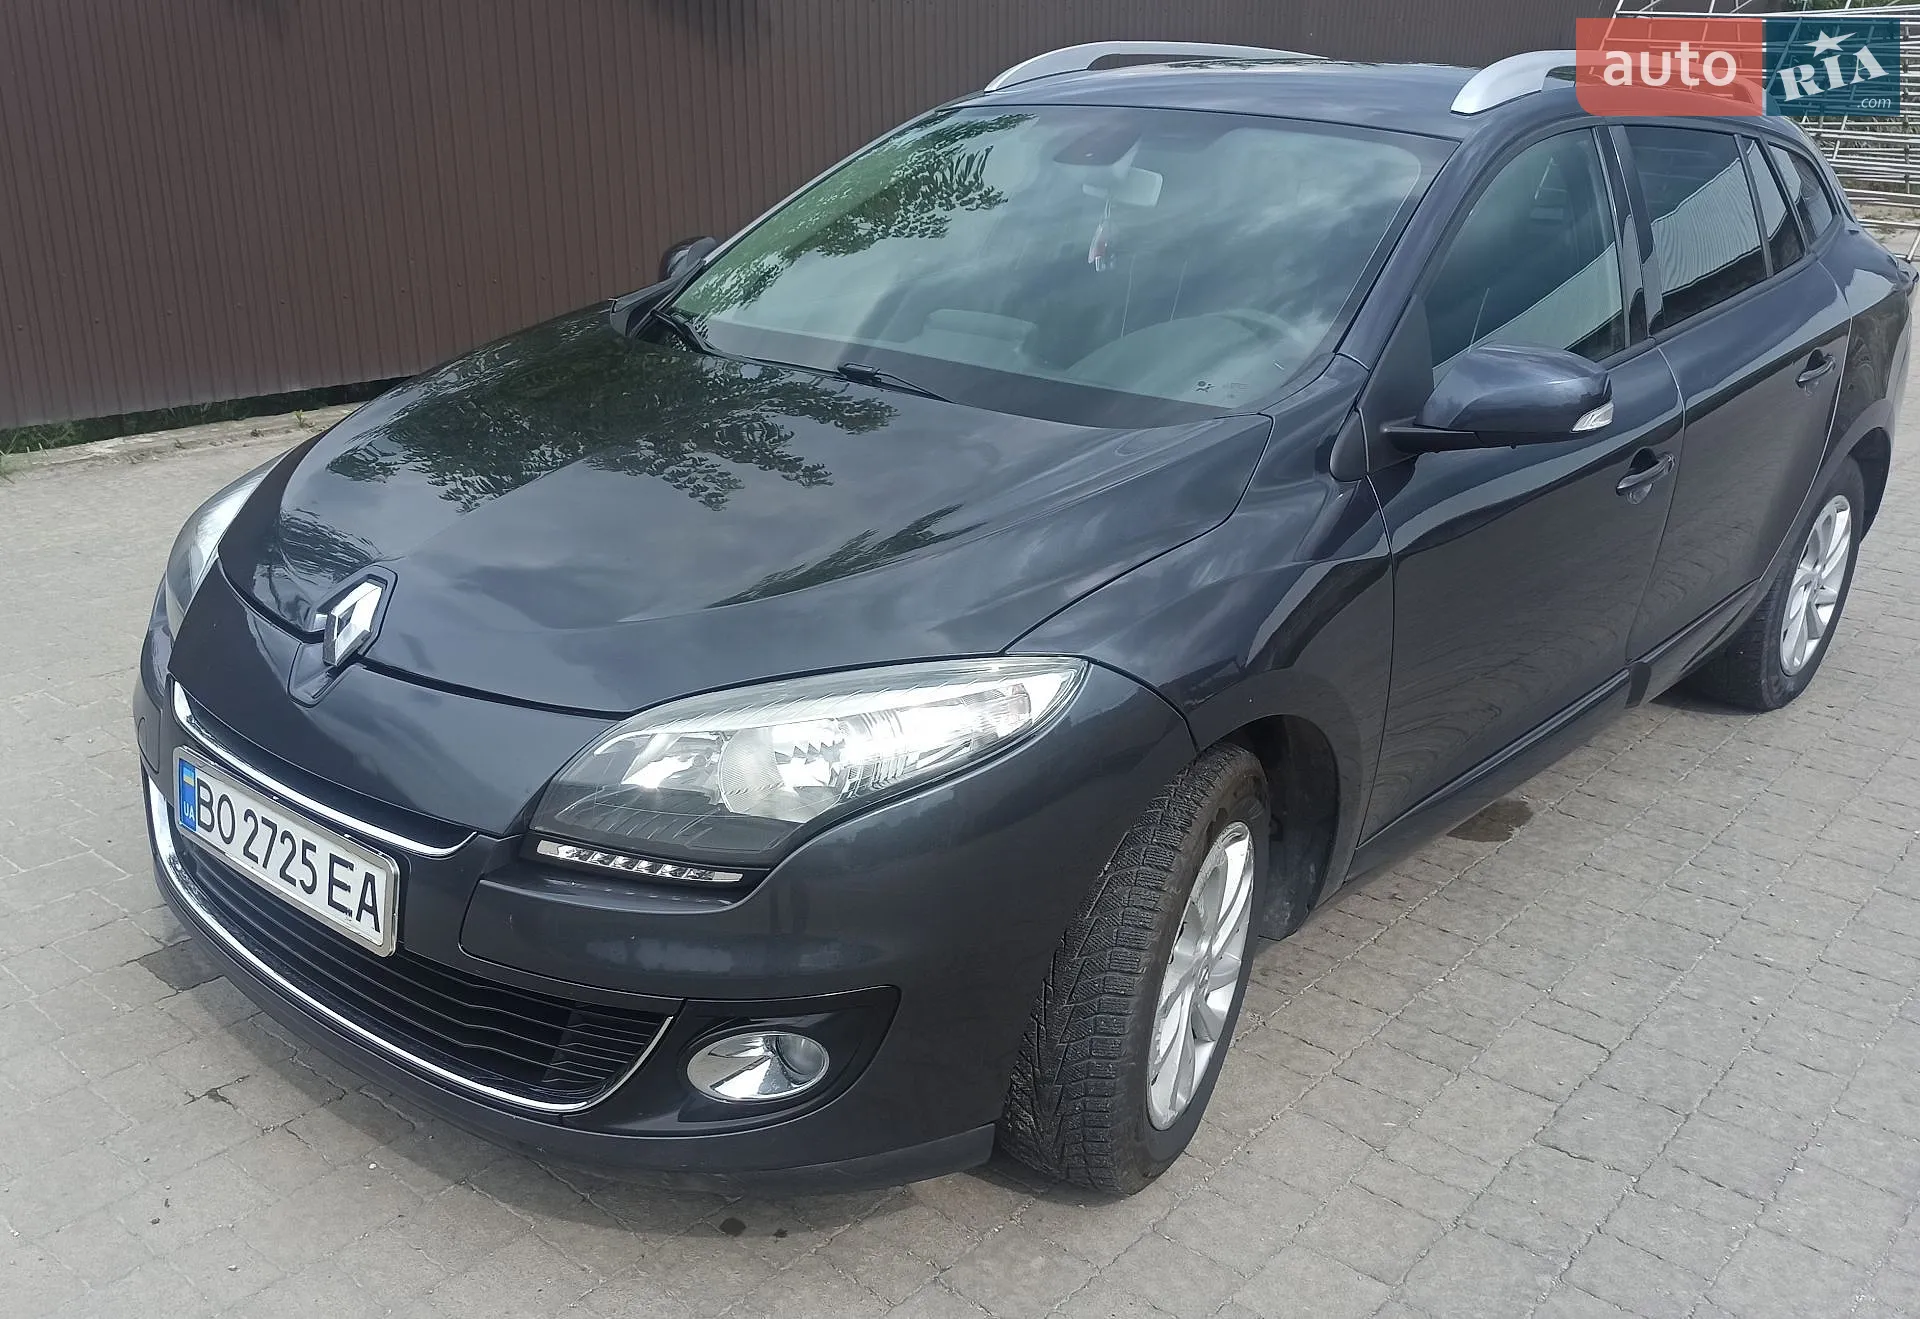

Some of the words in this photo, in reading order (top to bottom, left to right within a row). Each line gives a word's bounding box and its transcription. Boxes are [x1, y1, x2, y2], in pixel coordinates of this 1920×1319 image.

[183, 801, 195, 821] UA
[197, 778, 236, 844] BO
[243, 809, 318, 895] 2725
[327, 853, 381, 932] EA
